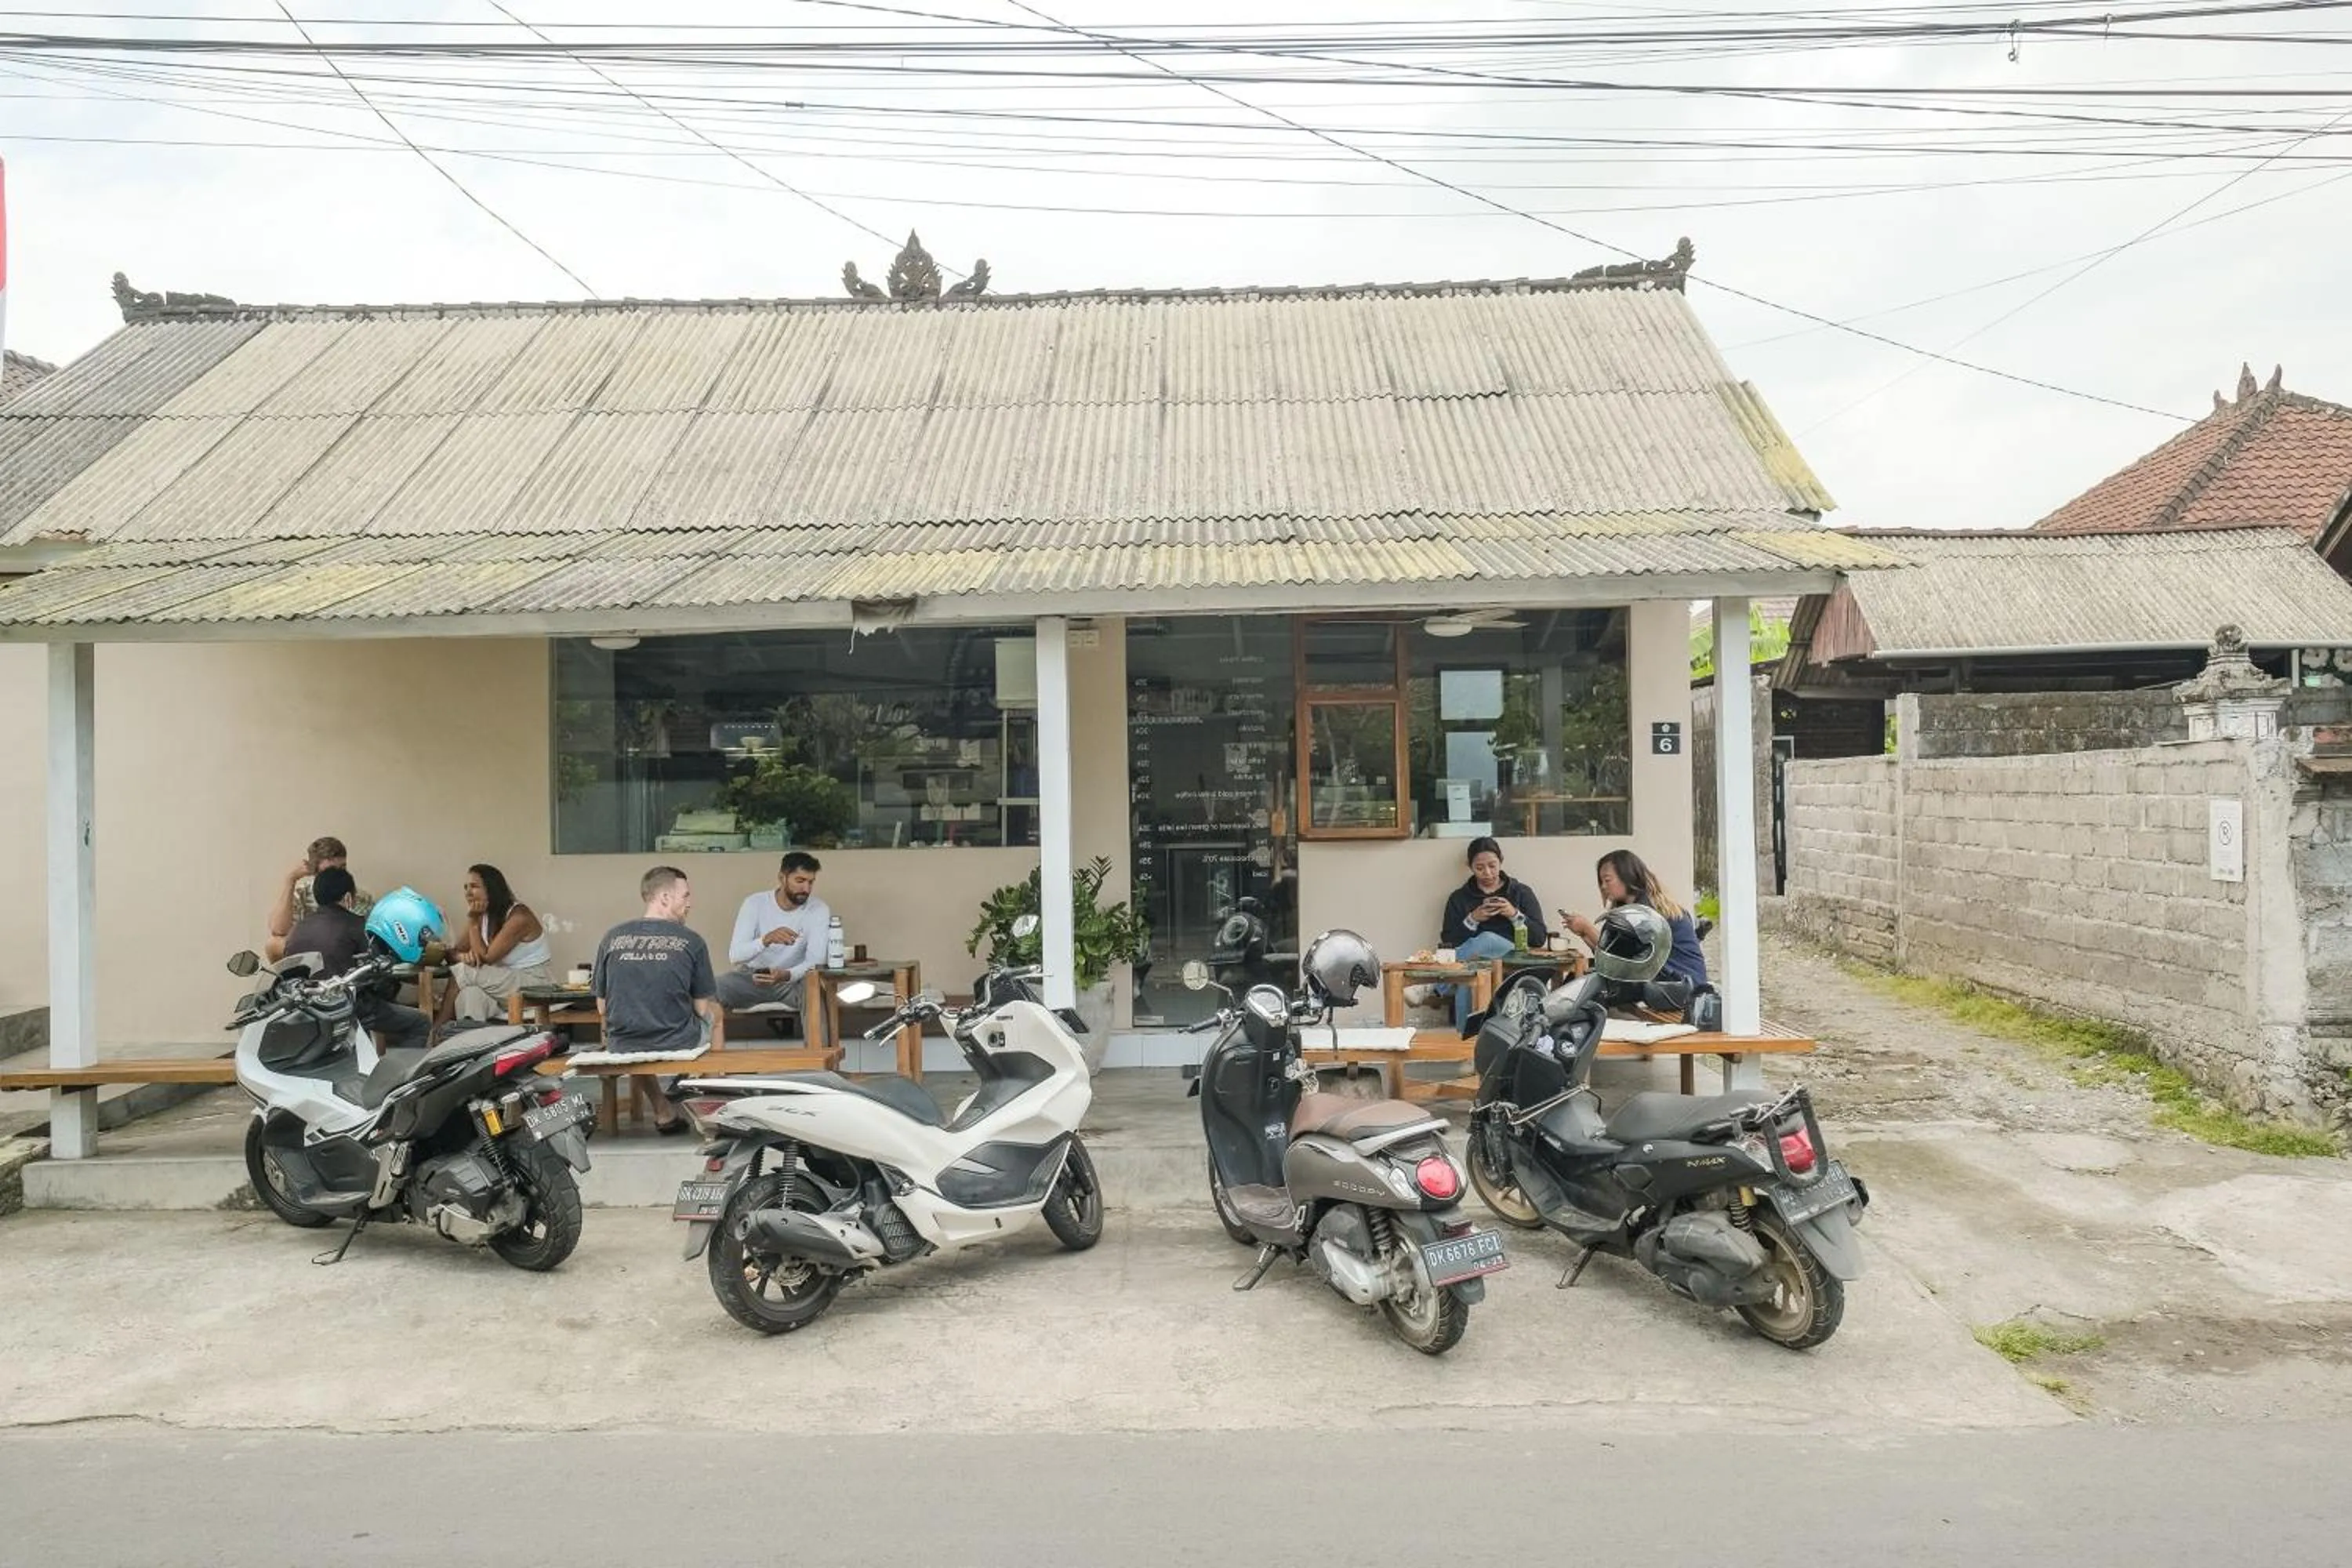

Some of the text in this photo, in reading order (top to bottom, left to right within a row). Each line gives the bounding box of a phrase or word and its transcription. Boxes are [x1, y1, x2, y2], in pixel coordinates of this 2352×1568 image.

[1660, 738, 1672, 752] 6
[1428, 1249, 1446, 1269] DK
[1446, 1243, 1475, 1261] 6676
